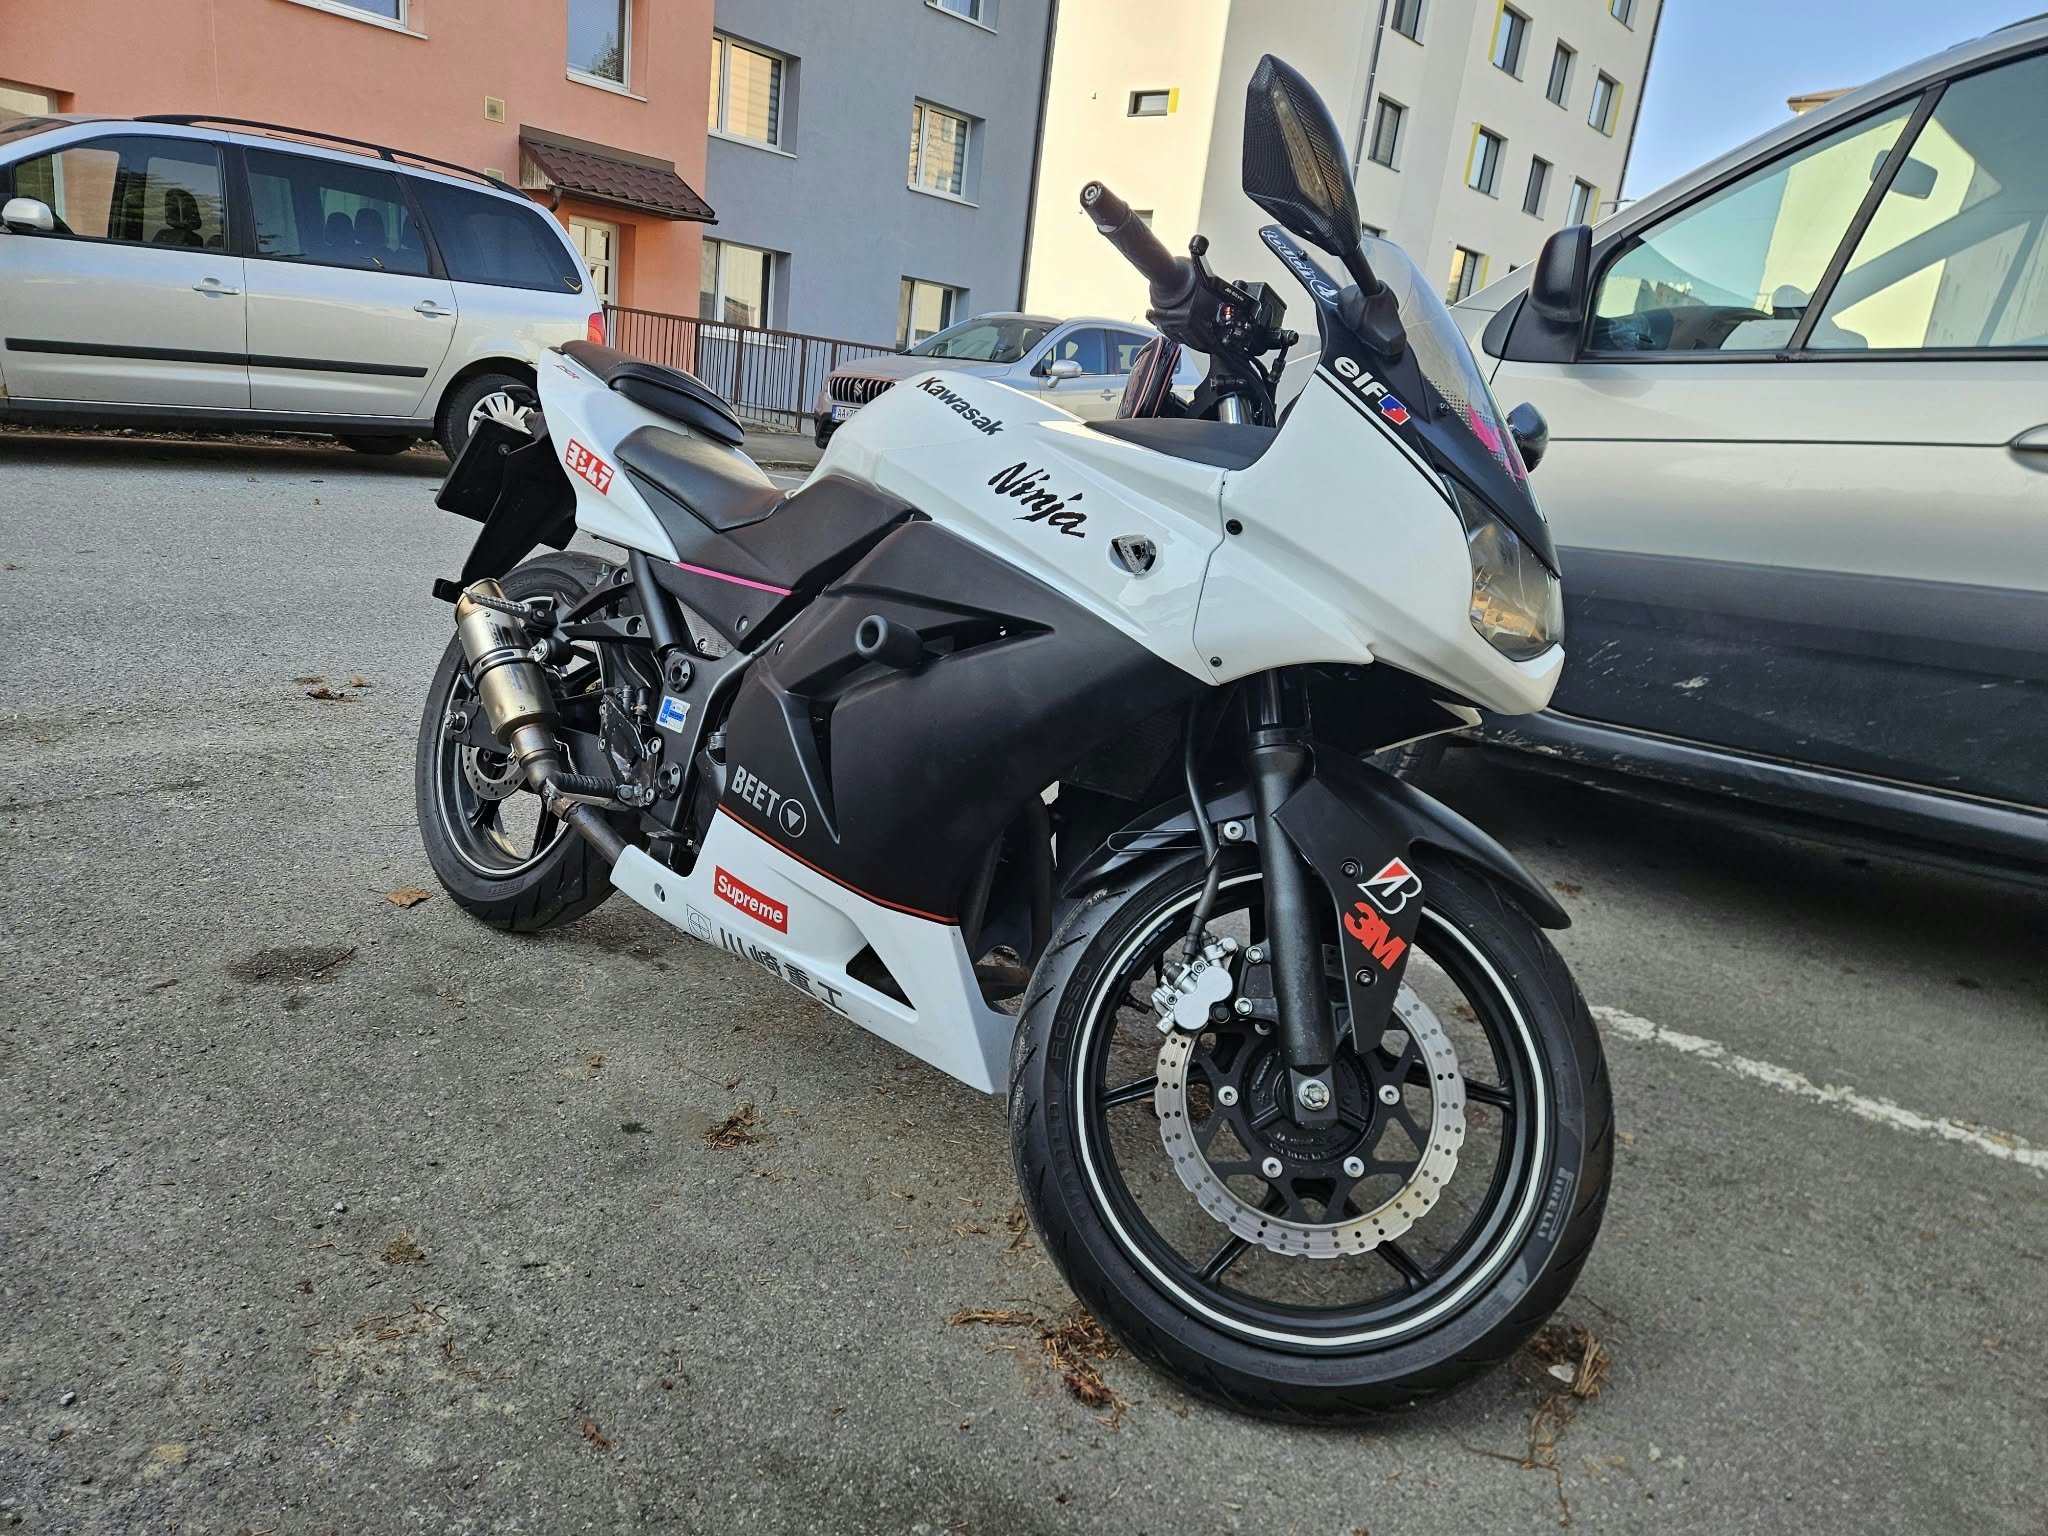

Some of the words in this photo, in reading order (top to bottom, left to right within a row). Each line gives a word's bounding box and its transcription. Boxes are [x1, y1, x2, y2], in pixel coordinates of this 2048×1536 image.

[1334, 356, 1389, 398] elf
[987, 461, 1088, 539] Ninja
[731, 764, 781, 819] BEET
[717, 874, 784, 924] Supreme
[1343, 901, 1408, 970] 3M
[720, 927, 848, 1015] 川崎重工
[1051, 963, 1093, 1060] ROSSO
